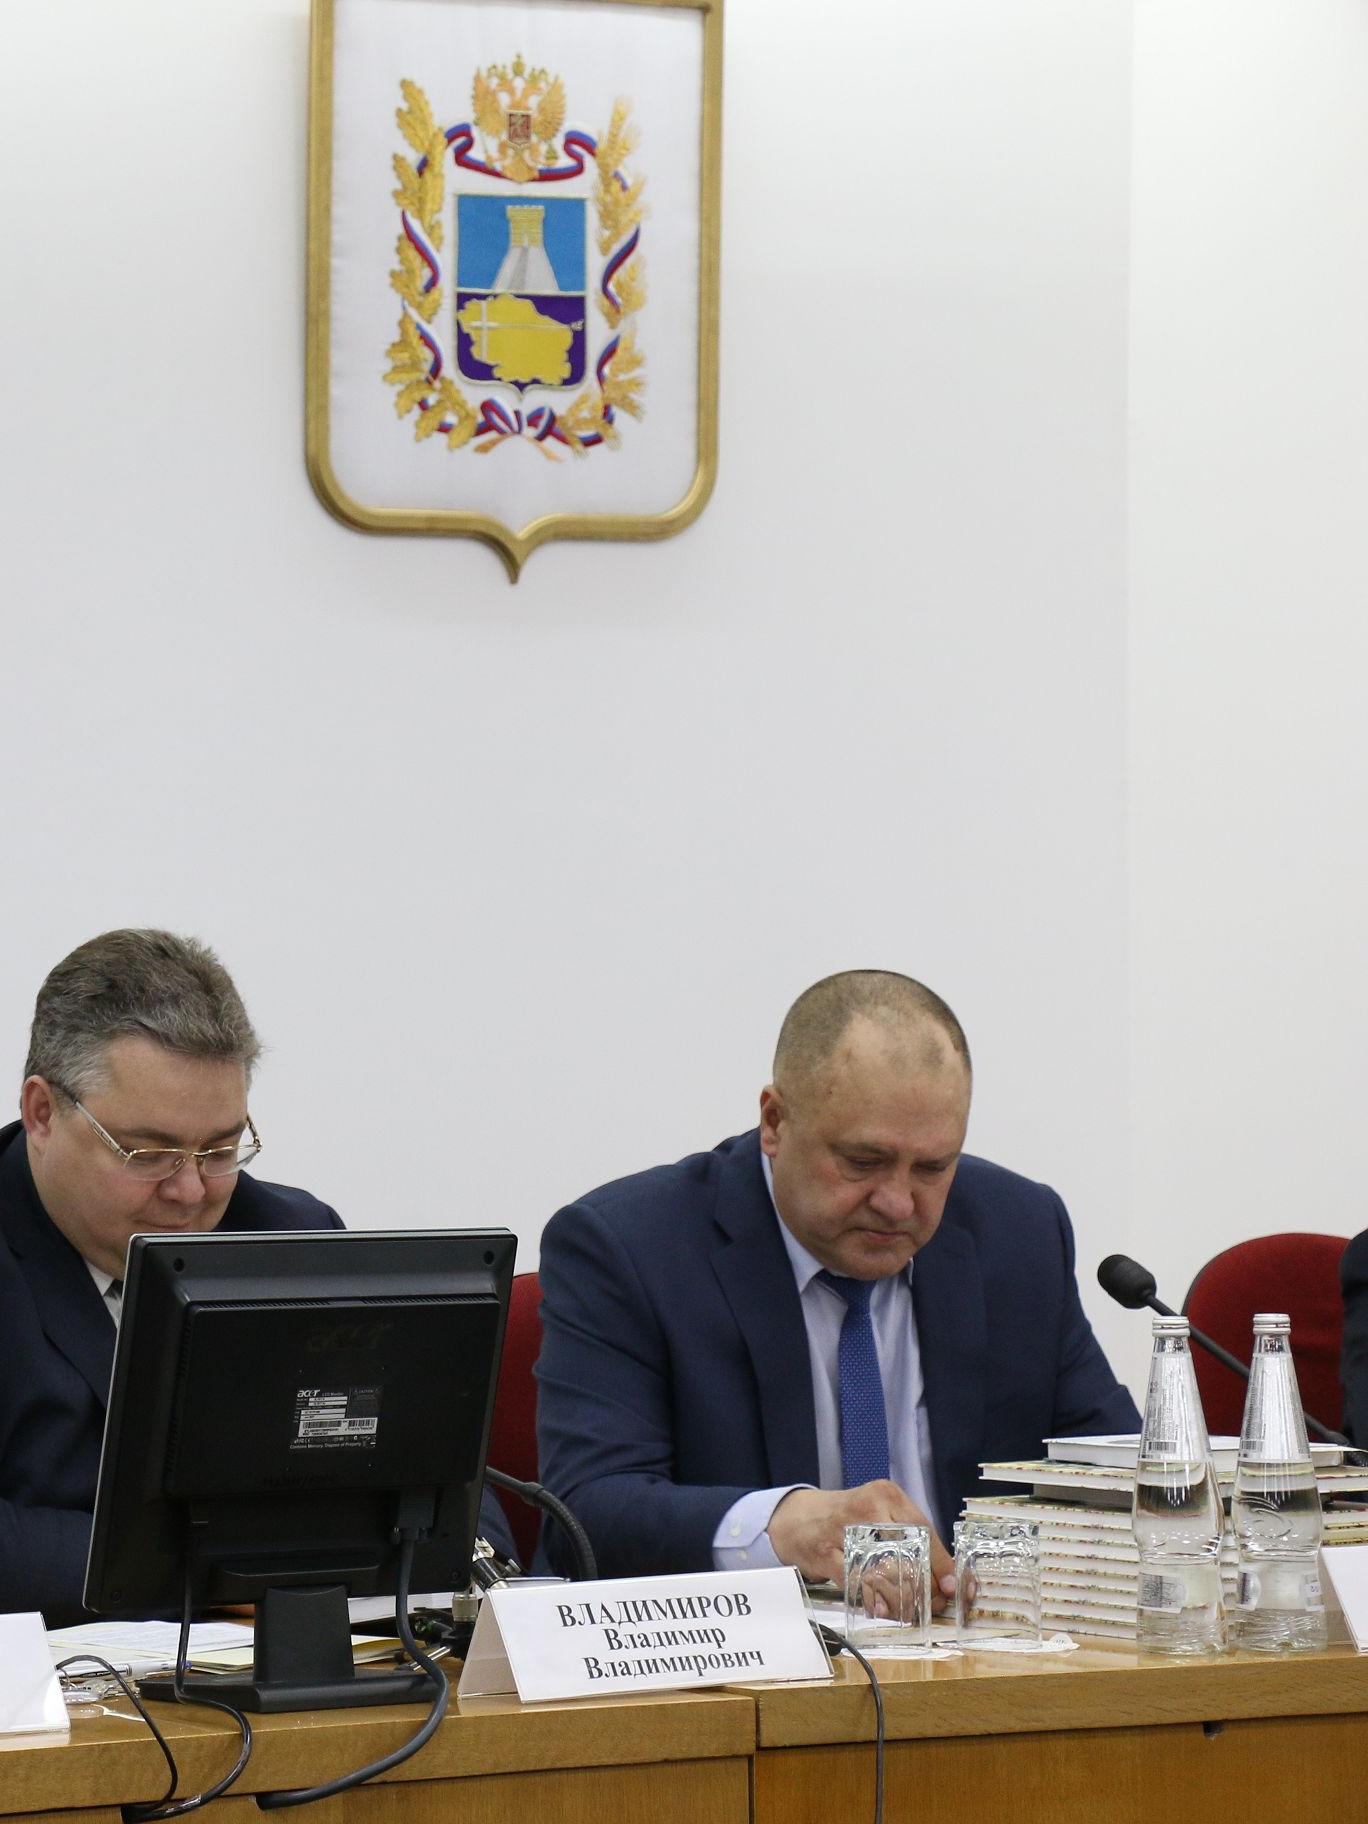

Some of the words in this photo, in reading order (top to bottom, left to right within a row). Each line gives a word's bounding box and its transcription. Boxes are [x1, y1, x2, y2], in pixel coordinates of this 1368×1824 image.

[297, 1389, 320, 1398] acer
[555, 1593, 752, 1629] ВЛАДИМИРОВ
[604, 1627, 726, 1651] Владимир
[582, 1650, 765, 1680] Владимирович
